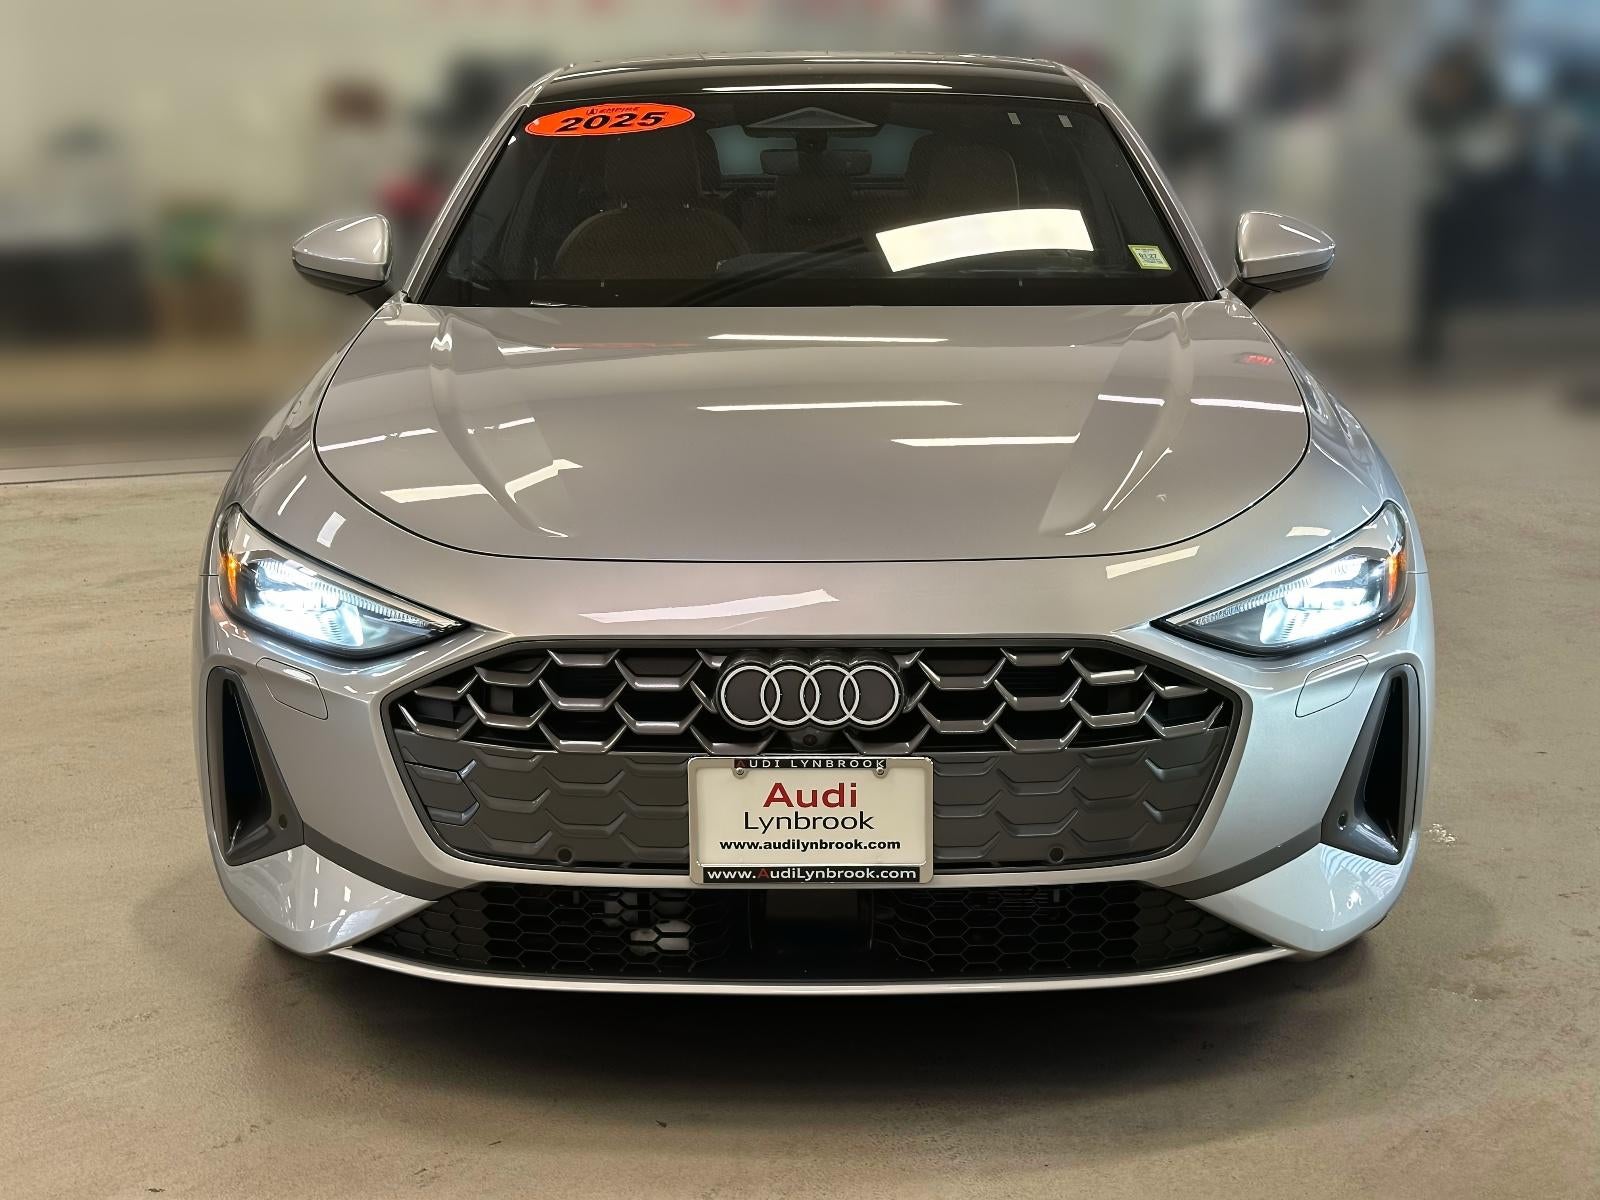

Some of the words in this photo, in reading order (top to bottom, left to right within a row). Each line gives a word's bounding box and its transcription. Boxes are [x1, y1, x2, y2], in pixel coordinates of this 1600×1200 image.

[554, 111, 669, 132] 2025
[736, 759, 780, 768] AUDI
[790, 759, 886, 768] LYNBROOK
[763, 782, 857, 808] Audi
[744, 811, 875, 834] Lynbrook
[719, 839, 901, 852] www.audilynbrook.com
[707, 868, 917, 881] www.AudiLynbrook.com
